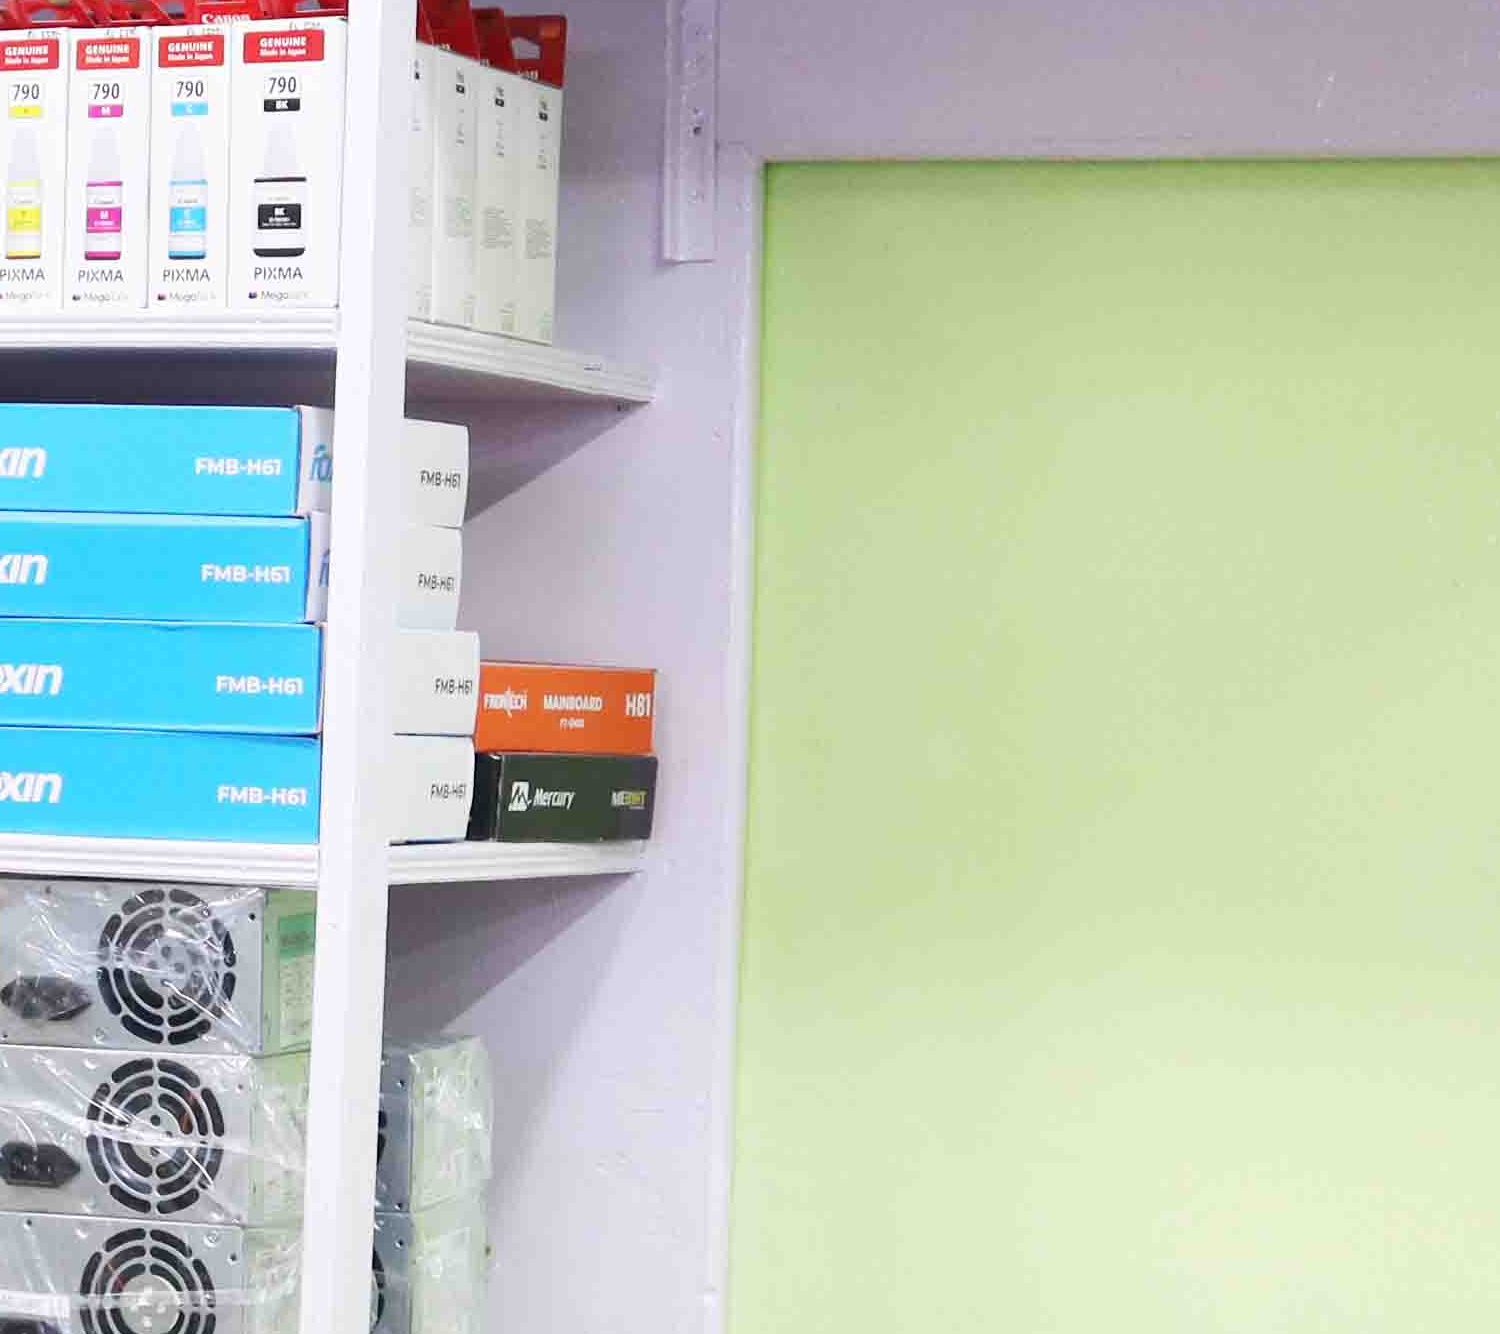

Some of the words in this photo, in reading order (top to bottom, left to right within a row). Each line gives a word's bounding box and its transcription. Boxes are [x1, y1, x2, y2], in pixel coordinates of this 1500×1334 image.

[5, 45, 48, 56] GENUINE
[86, 43, 129, 55] GENUINE
[168, 41, 213, 54] GENUINE
[13, 84, 39, 100] 790
[93, 83, 120, 99] 790
[176, 81, 204, 97] 790
[269, 76, 297, 93] 790
[275, 100, 289, 109] BK
[196, 459, 281, 476] FMB-H61
[201, 565, 291, 583] FMB-H61
[216, 676, 304, 695] FMB-H61
[543, 694, 602, 712] MAINBOARD
[217, 787, 307, 805] FMB-H61
[534, 787, 575, 810] Mercury
